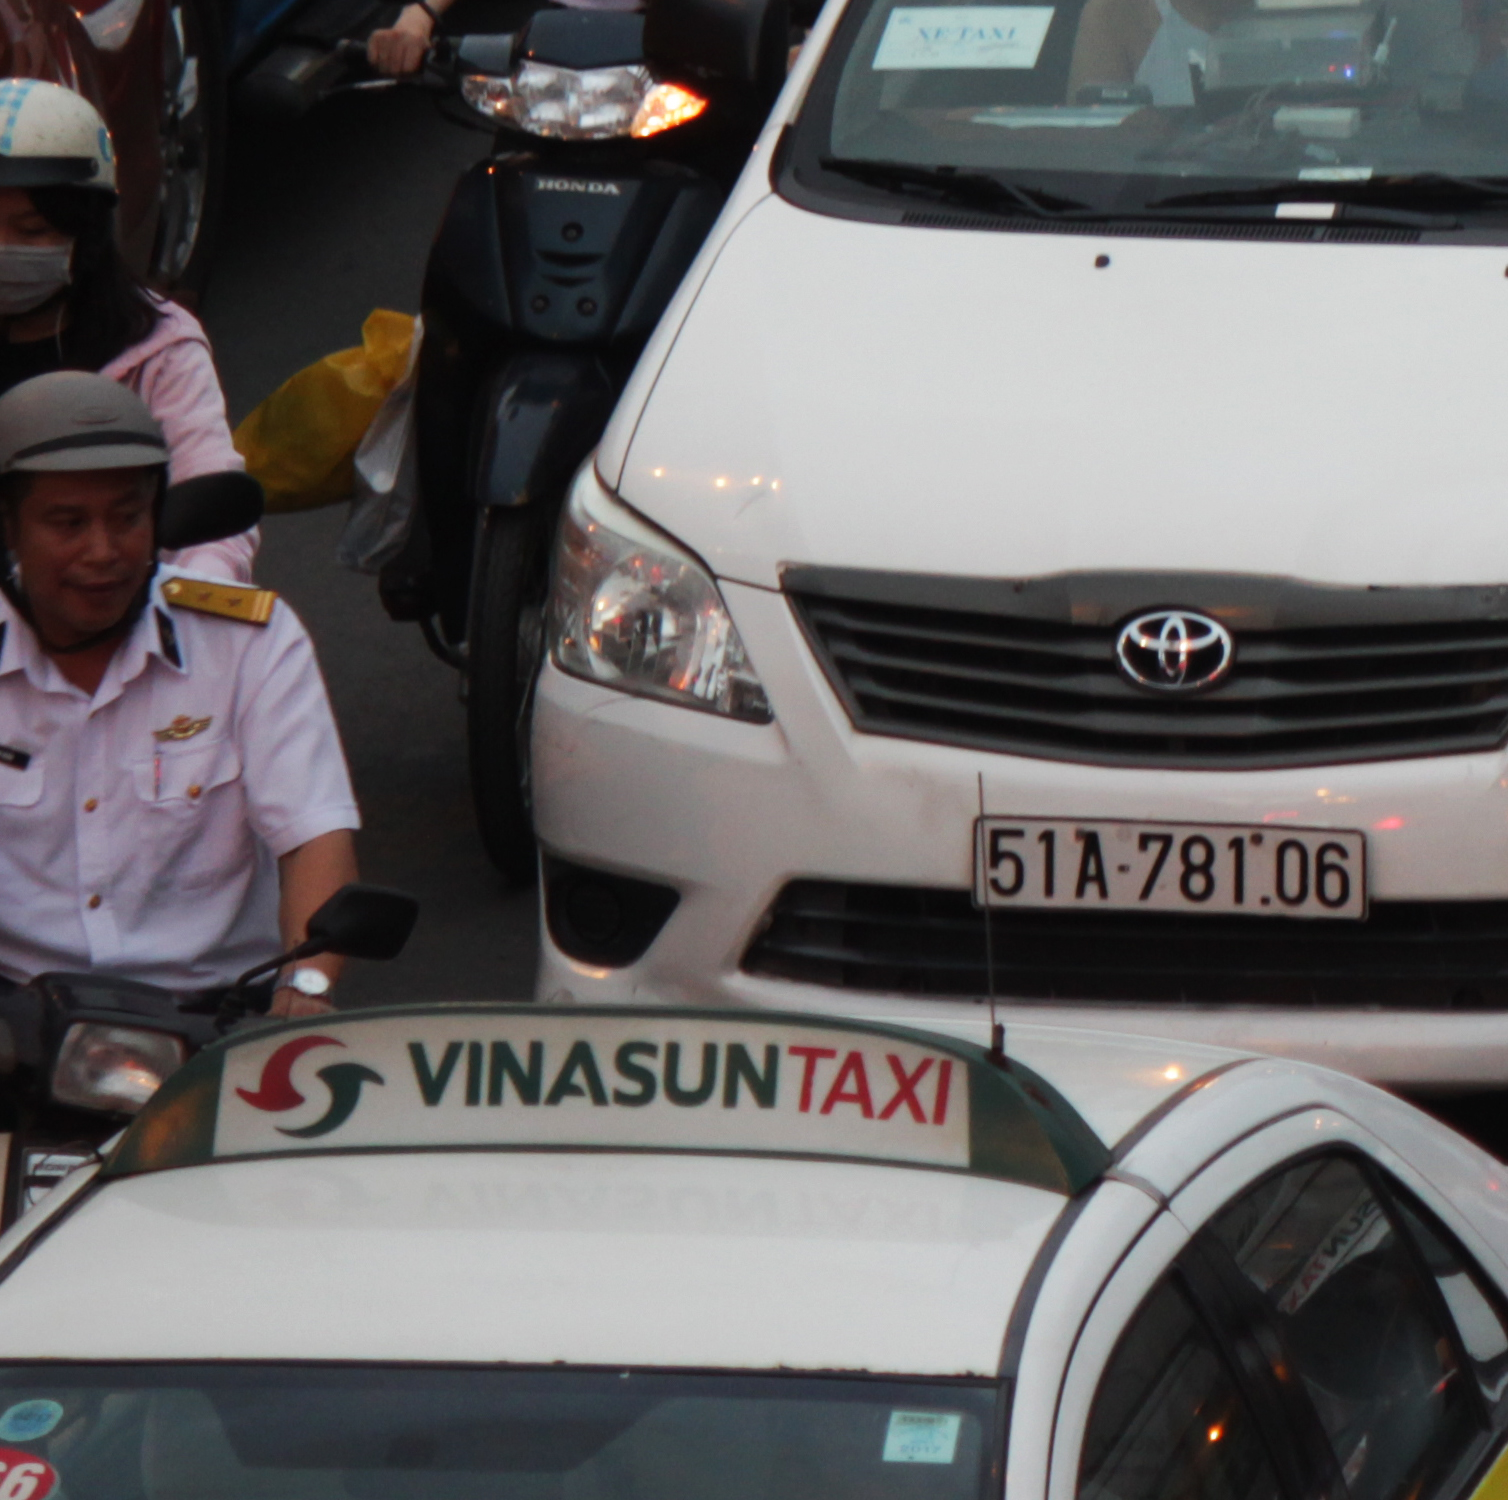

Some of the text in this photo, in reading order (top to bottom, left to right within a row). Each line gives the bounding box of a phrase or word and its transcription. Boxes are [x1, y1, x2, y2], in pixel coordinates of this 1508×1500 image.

[537, 178, 620, 196] HONDA
[989, 828, 1351, 909] 51A-781.06
[407, 1040, 954, 1126] VINASUNTAXI
